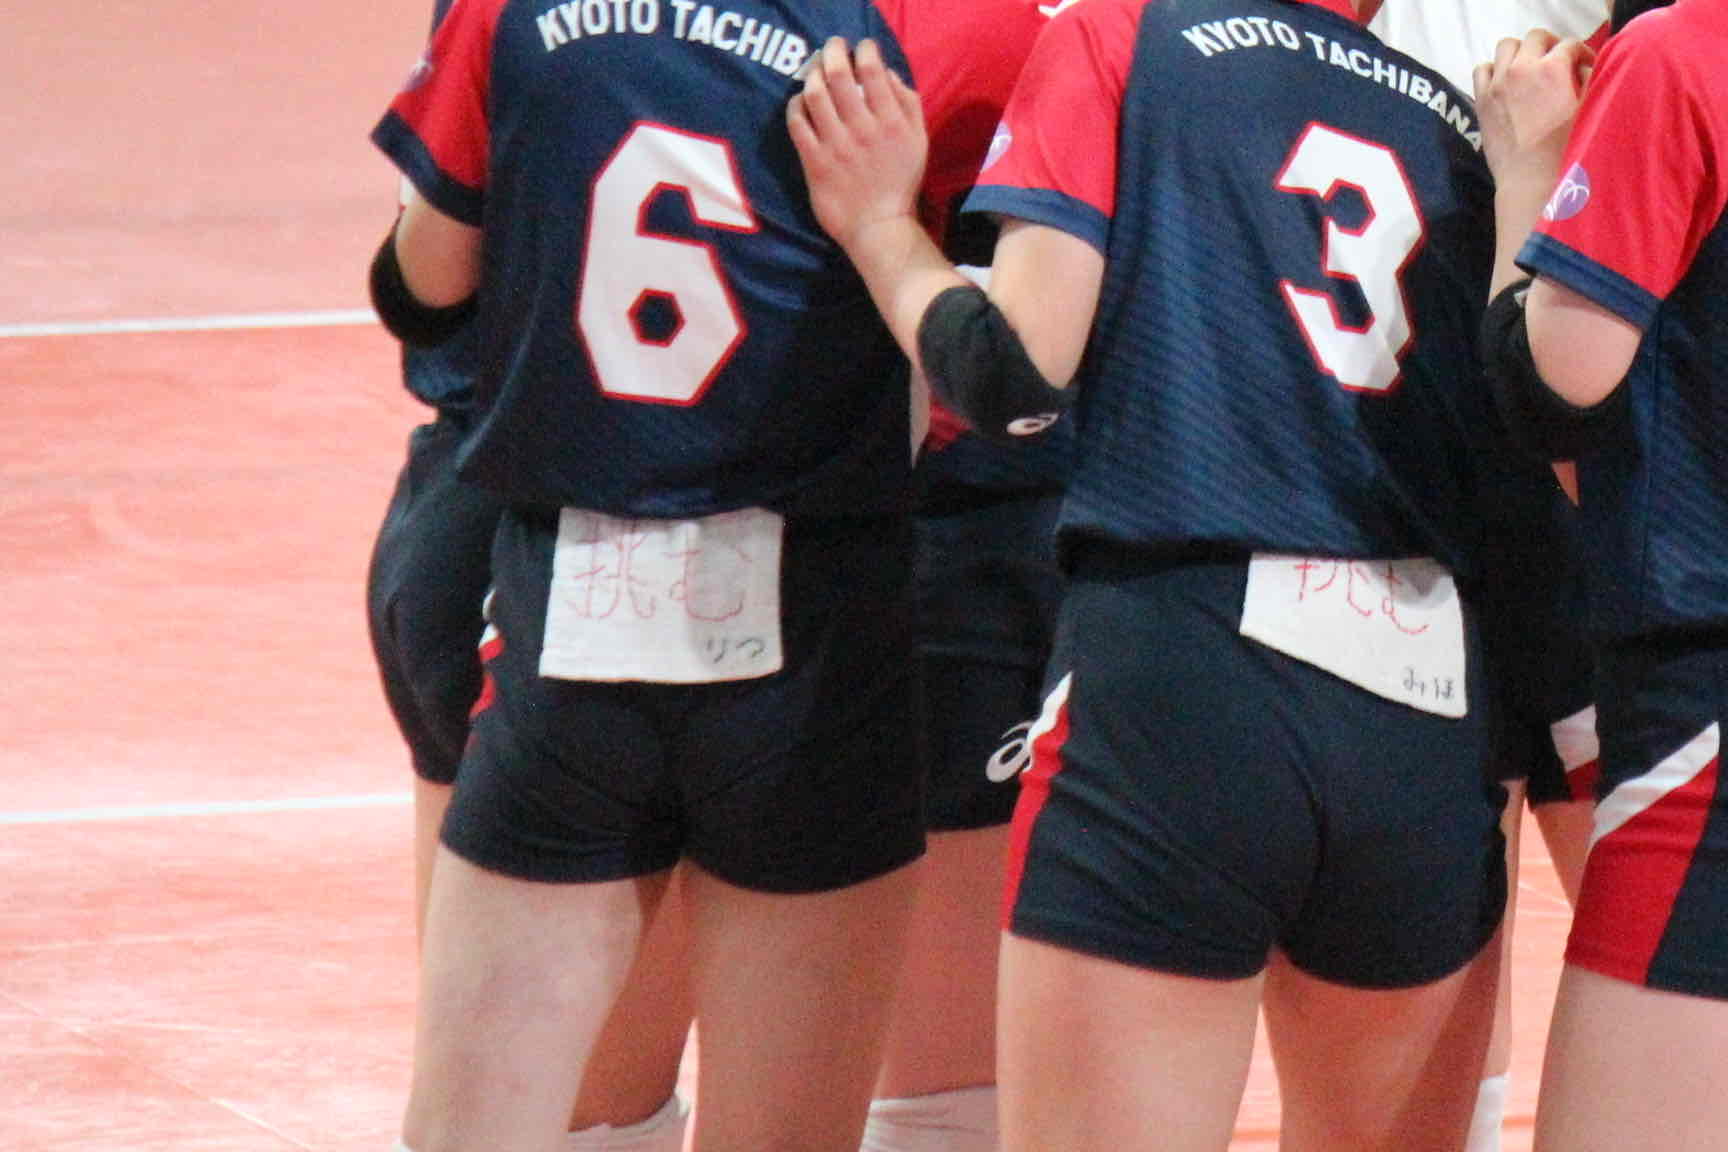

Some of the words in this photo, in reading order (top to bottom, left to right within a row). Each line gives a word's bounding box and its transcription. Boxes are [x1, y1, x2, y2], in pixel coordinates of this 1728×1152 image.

[1181, 16, 1300, 57] KYOTO
[573, 120, 761, 407] 6
[1272, 120, 1429, 393] 3
